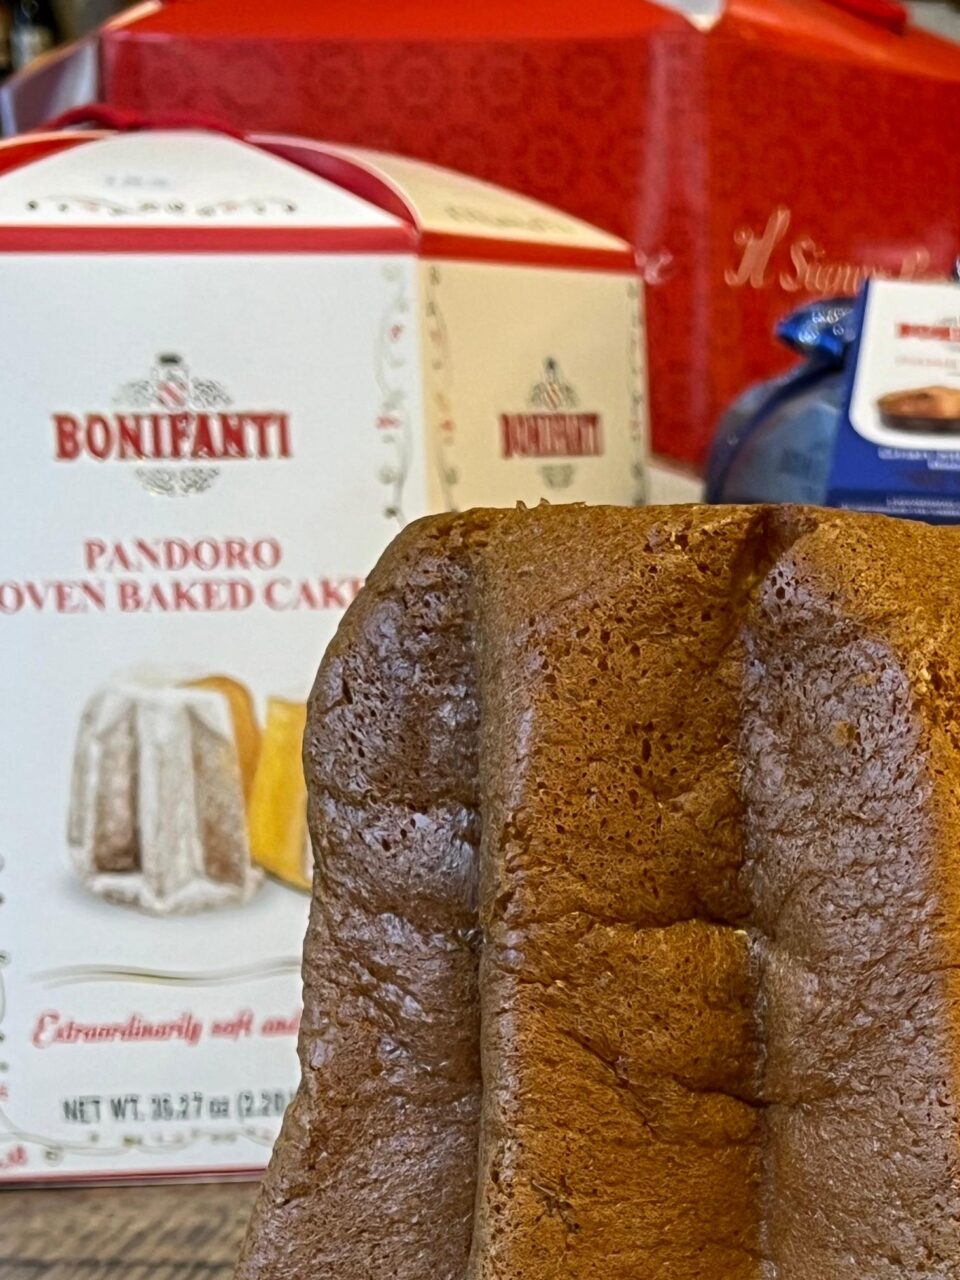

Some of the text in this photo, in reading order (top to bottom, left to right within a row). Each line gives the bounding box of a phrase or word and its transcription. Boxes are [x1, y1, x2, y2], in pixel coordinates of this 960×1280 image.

[52, 411, 292, 461] BONIFANTI
[83, 535, 283, 572] PANDORO
[0, 578, 107, 615] OVEN
[117, 577, 256, 613] BAKED
[62, 1094, 103, 1124] NET
